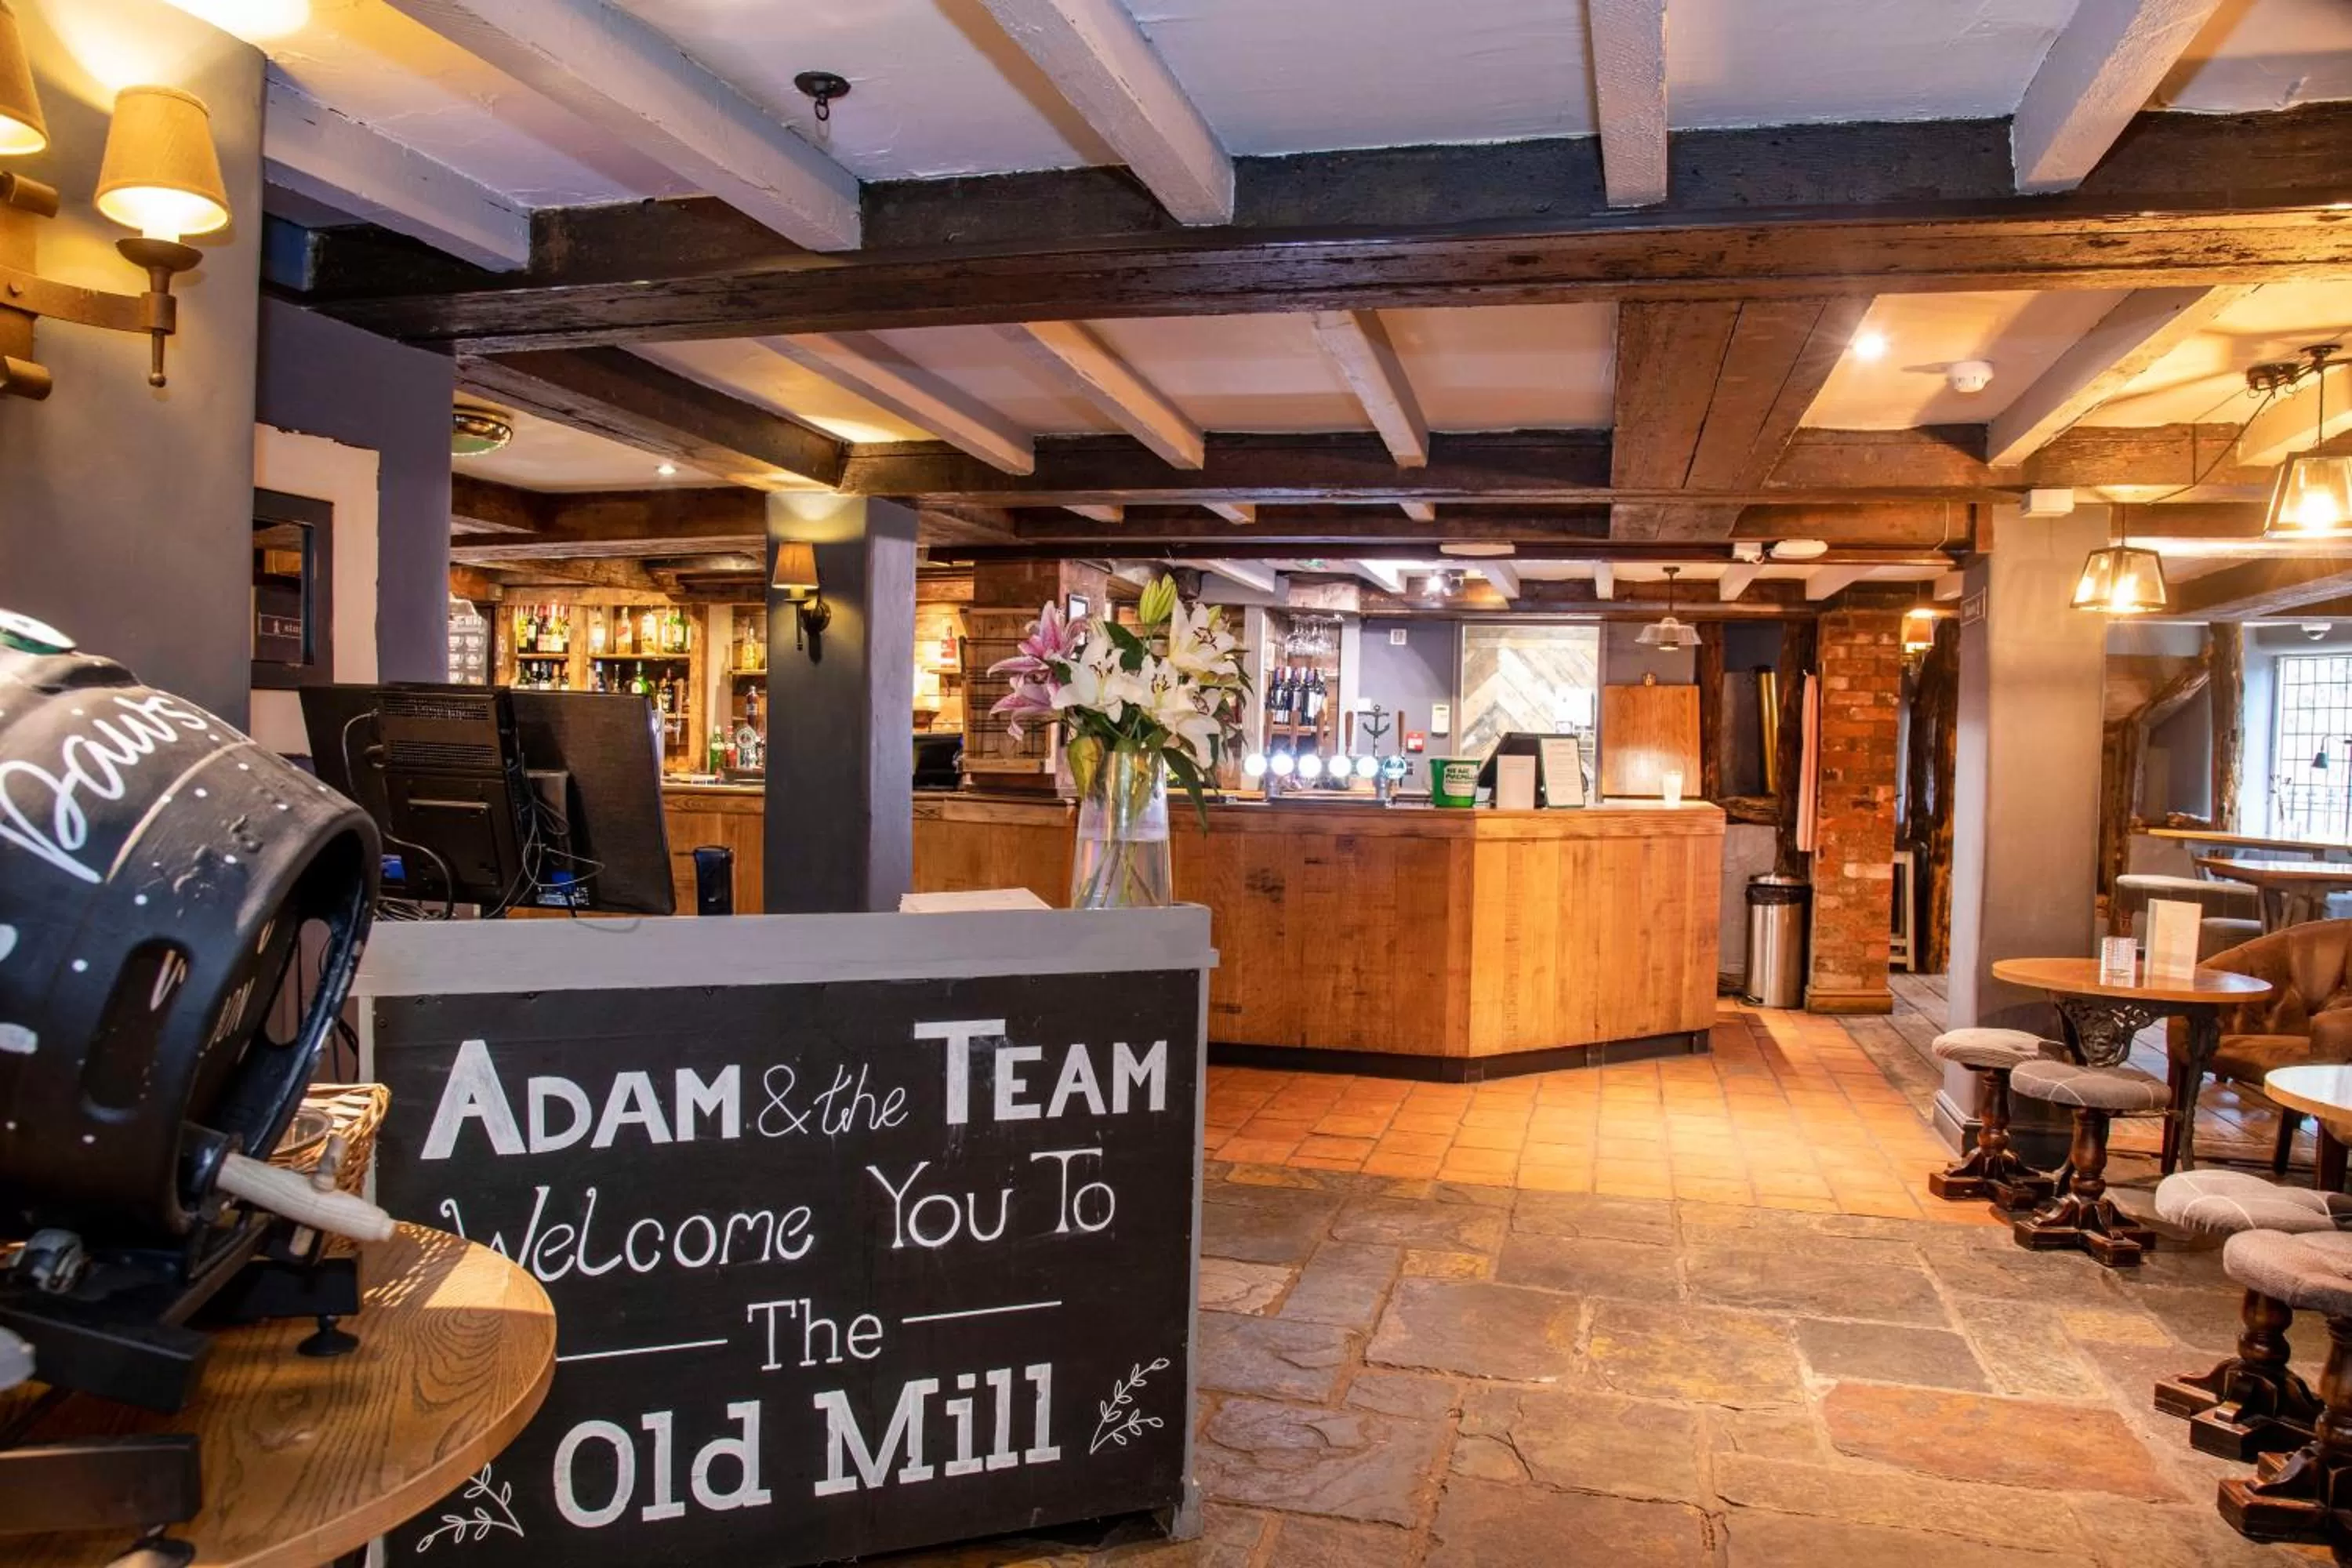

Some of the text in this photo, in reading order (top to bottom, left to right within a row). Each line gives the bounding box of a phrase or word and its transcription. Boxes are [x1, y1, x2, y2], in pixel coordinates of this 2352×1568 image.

[420, 1018, 1167, 1159] ADAM & the TEAM
[440, 1185, 814, 1282] Welcome
[1030, 1147, 1116, 1233] To
[746, 1298, 883, 1371] The
[554, 1363, 1061, 1528] Old Mill
